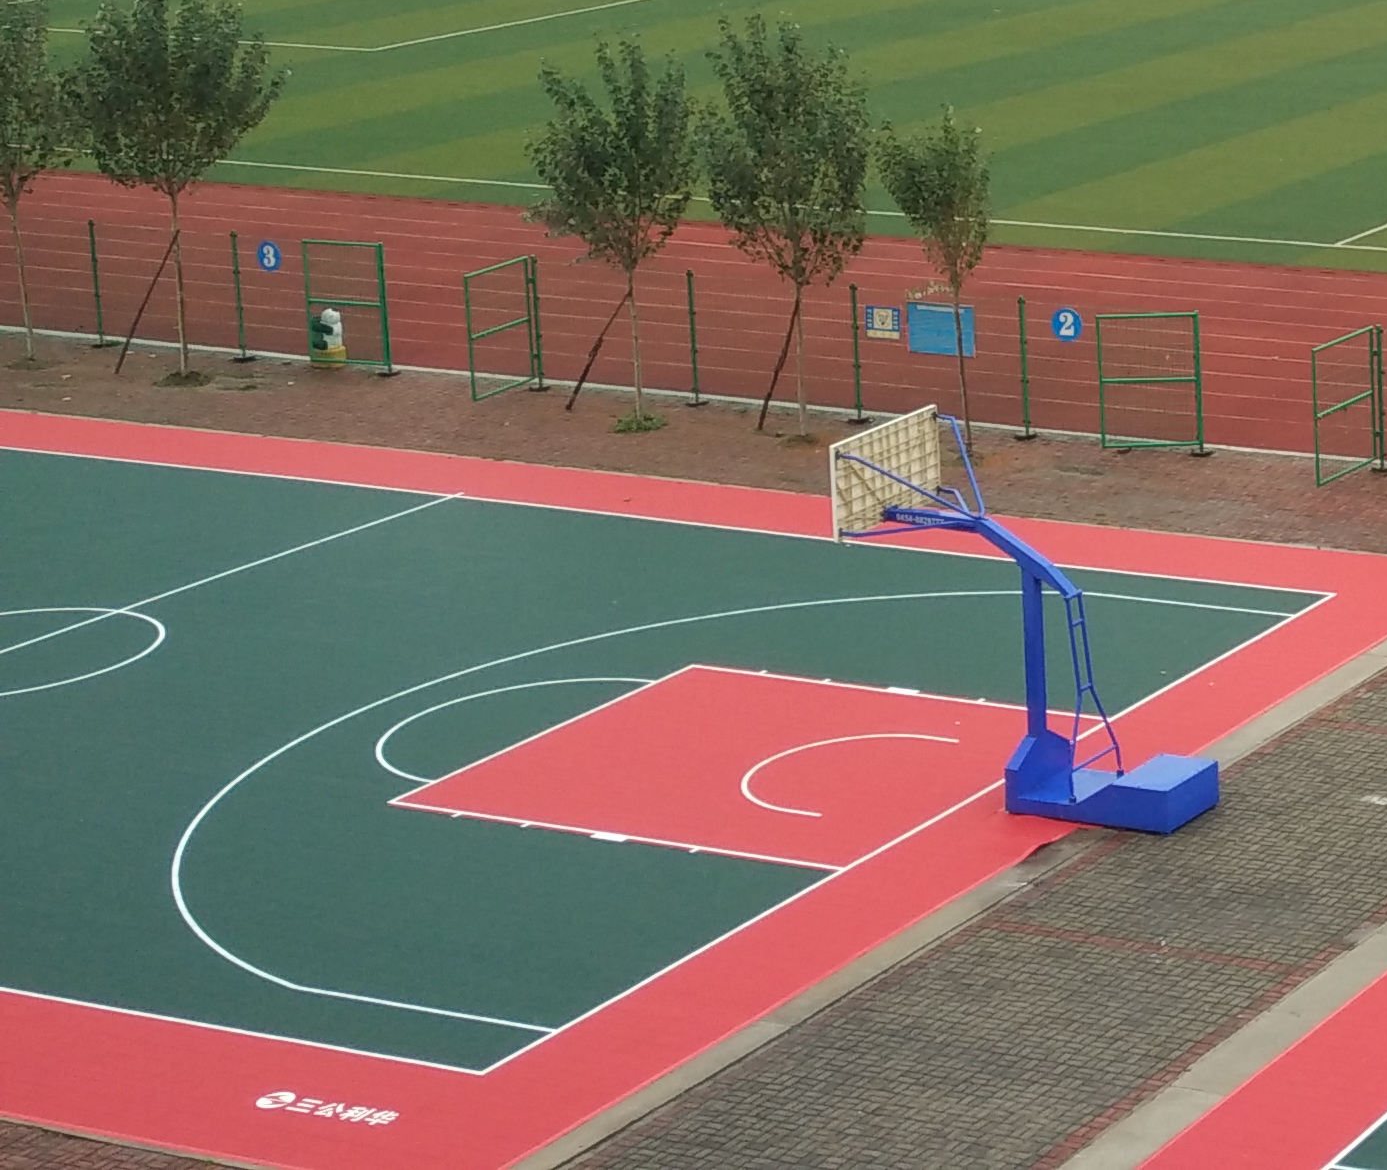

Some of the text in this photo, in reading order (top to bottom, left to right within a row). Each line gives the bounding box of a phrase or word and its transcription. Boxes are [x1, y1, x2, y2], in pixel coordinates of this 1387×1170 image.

[263, 245, 276, 268] 3
[1059, 312, 1075, 336] 2
[285, 1098, 399, 1125] 三公利华
